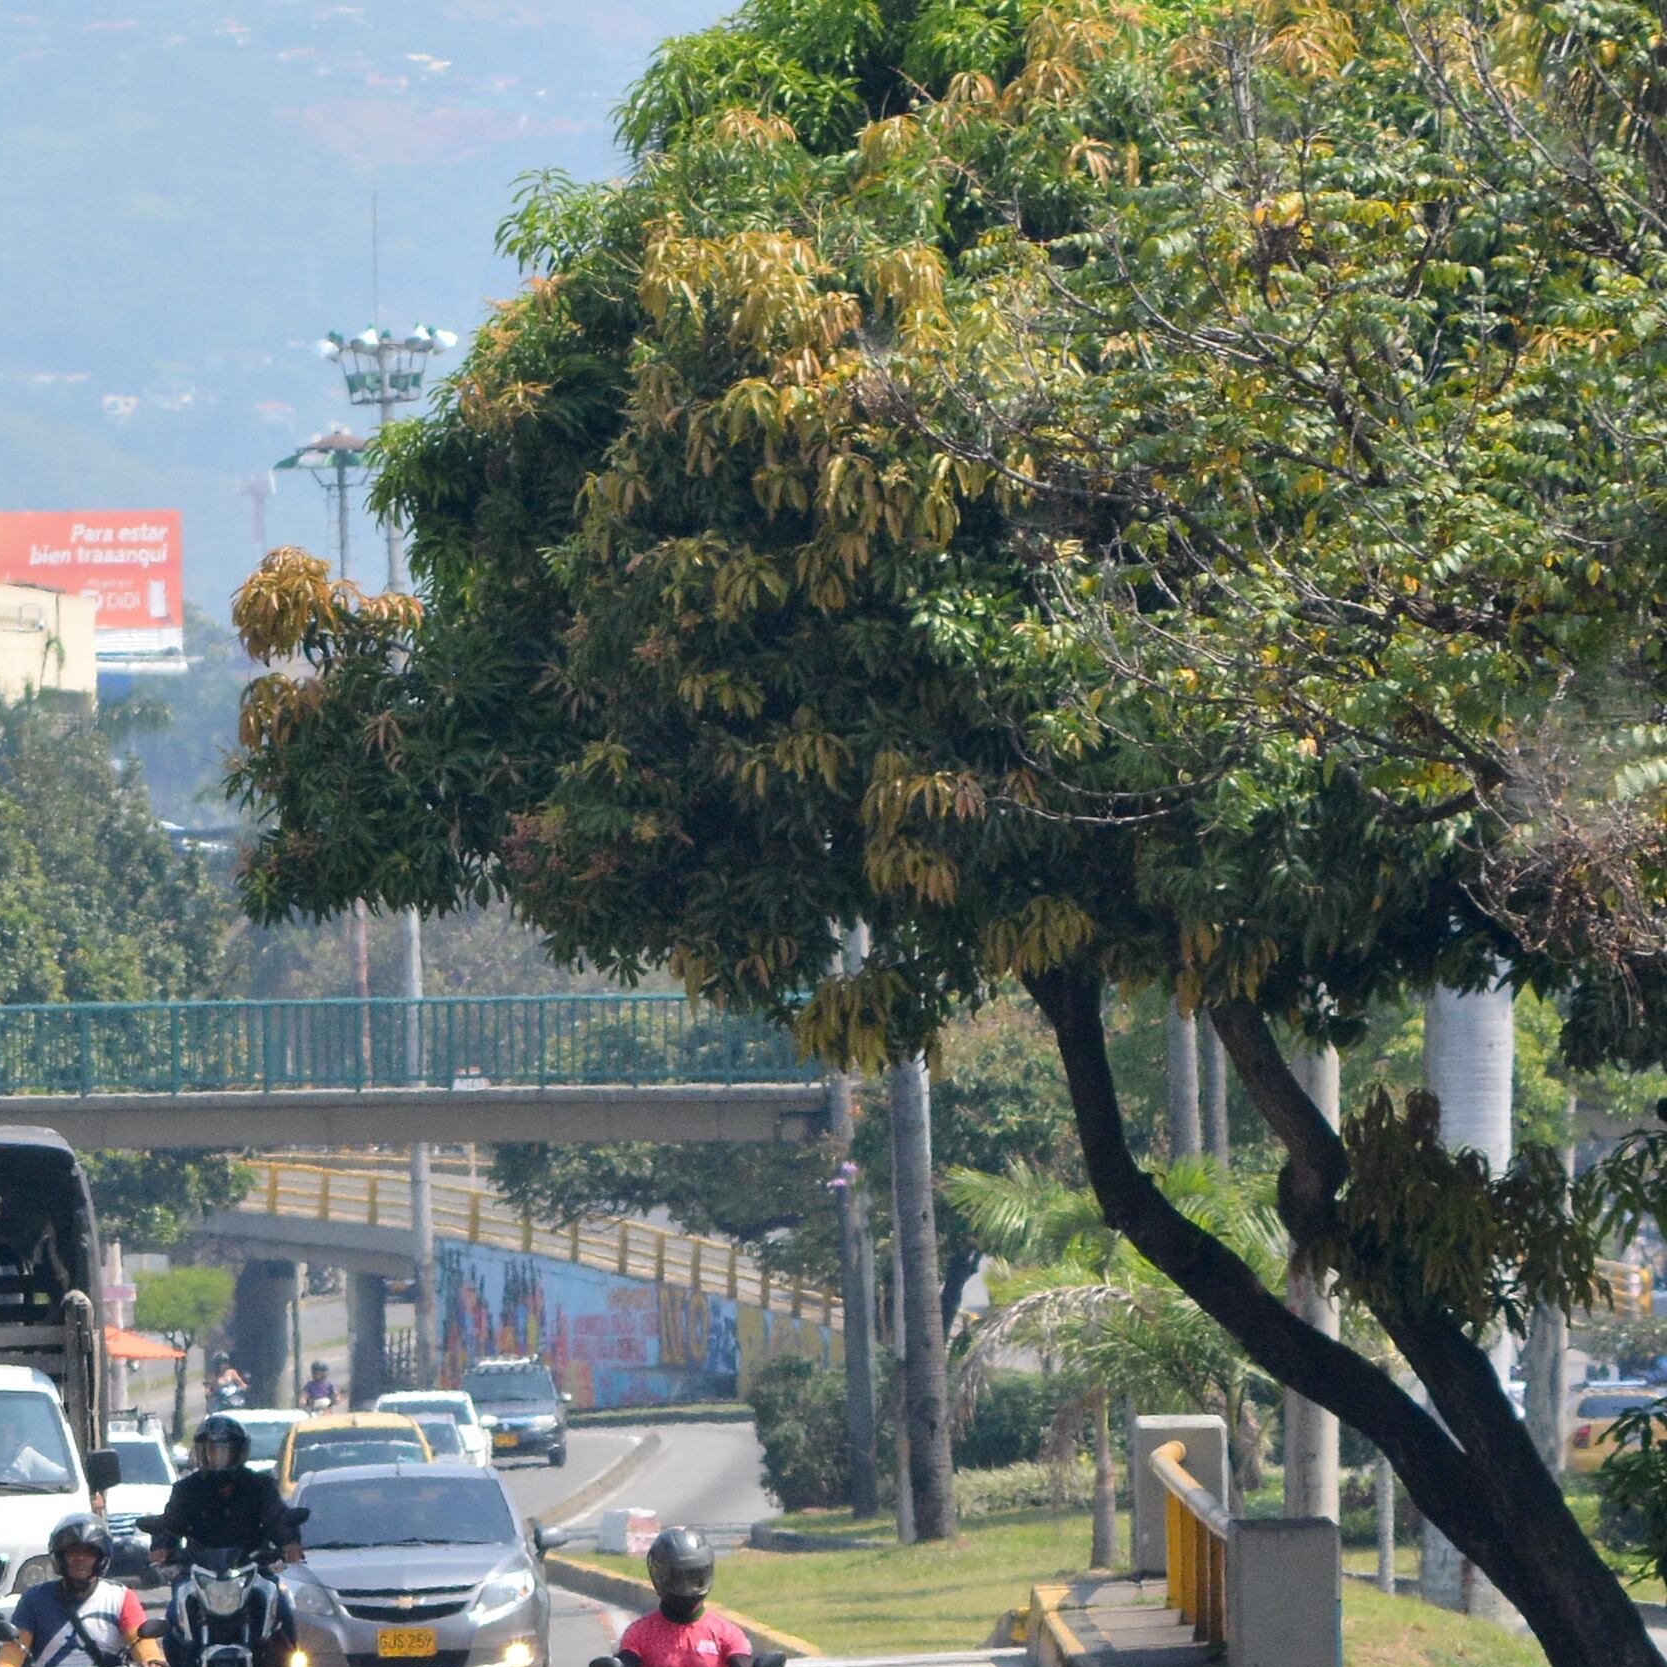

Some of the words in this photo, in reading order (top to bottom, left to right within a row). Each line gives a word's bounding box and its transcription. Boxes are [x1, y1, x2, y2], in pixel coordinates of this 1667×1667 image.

[70, 523, 114, 543] Para
[119, 525, 169, 543] estar
[29, 544, 71, 566] bien
